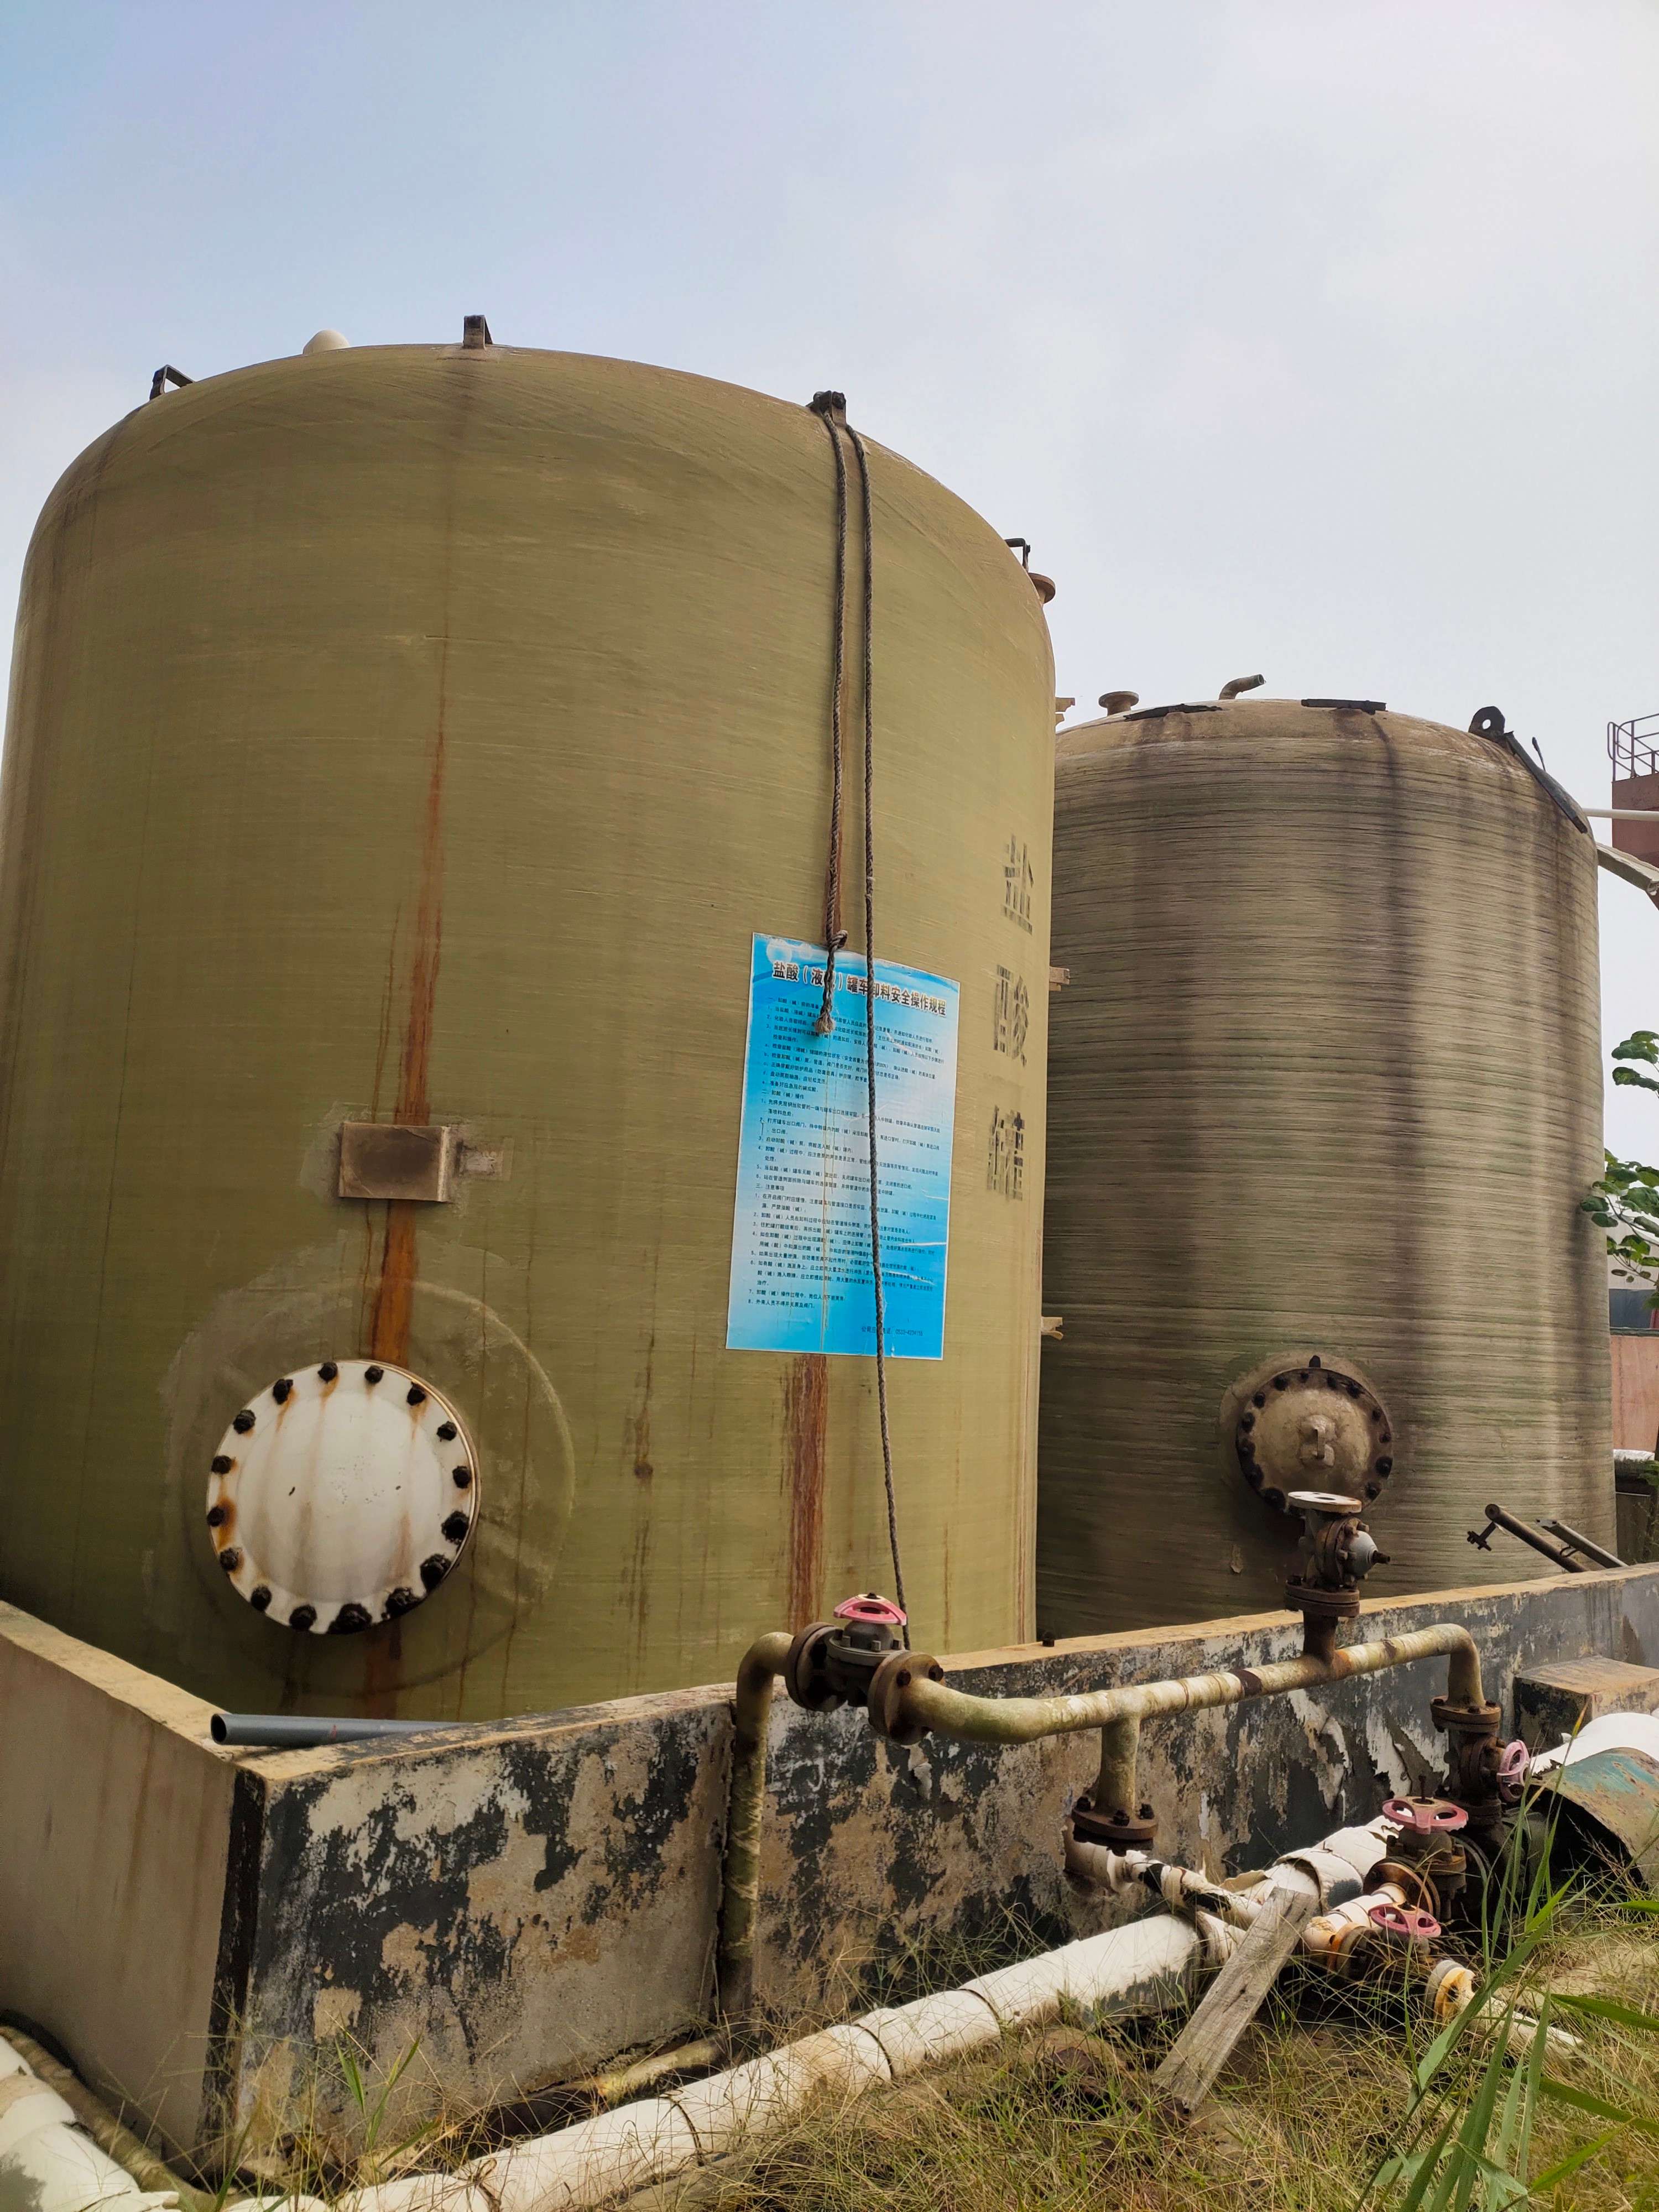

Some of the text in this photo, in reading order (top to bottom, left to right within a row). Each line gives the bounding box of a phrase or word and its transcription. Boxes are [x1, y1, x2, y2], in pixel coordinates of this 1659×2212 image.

[773, 962, 946, 1015] 盐酸（液）罐车卸料安全操作规程
[754, 1183, 785, 1191] 三、注意事项
